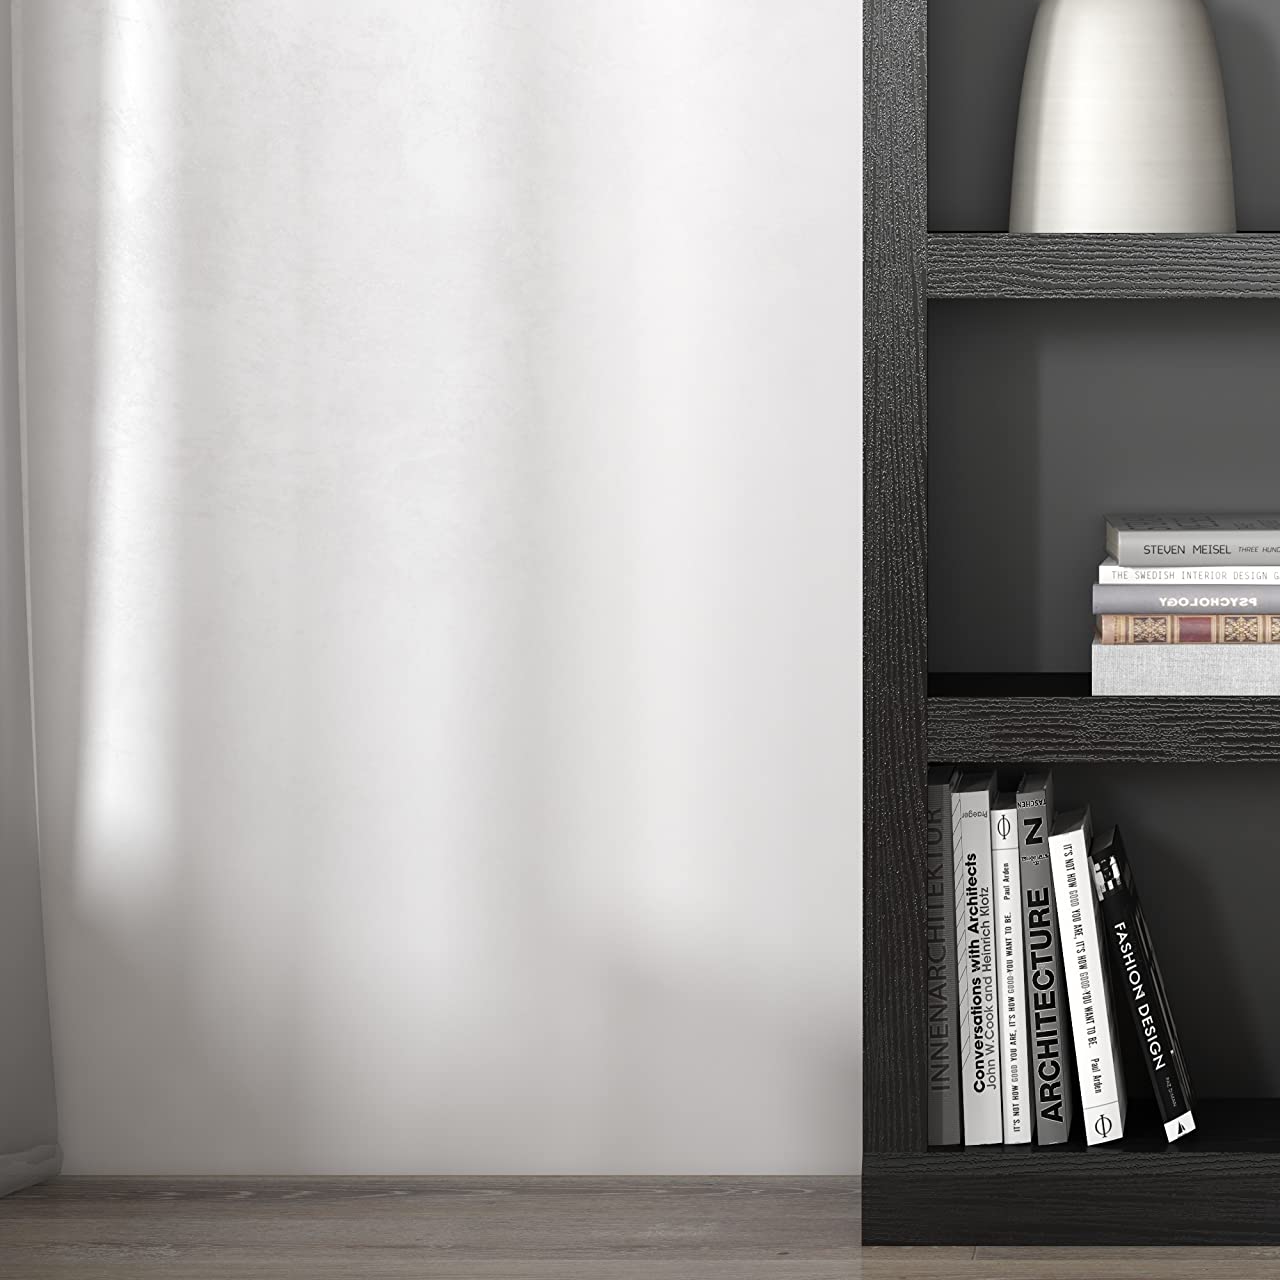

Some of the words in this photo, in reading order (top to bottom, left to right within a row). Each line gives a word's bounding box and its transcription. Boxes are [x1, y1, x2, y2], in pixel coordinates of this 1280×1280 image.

[1143, 545, 1186, 555] STEVEN
[1192, 545, 1231, 555] MEISEL
[1112, 571, 1129, 580] THE
[1135, 571, 1175, 580] SWEDISH
[1181, 571, 1227, 580] INTERIOR
[1233, 571, 1268, 580] DESIGN
[1017, 799, 1047, 808] TASCHEN
[962, 810, 988, 819] Praeger
[1063, 844, 1073, 857] IT'S
[1002, 862, 1010, 882] Arden
[1065, 858, 1075, 871] NOT
[1067, 873, 1077, 888] HOW
[964, 852, 980, 934] Architects
[1069, 890, 1079, 907] GOOD
[977, 886, 990, 917] Klotz
[1004, 912, 1012, 923] BE.
[1071, 908, 1081, 922] YOU
[1004, 926, 1012, 935] TO
[1073, 924, 1083, 940] ARE,
[928, 807, 950, 1091] INNENARCHITEKTUR
[978, 921, 991, 972] Heinrich
[1005, 937, 1013, 956] WANT
[1076, 941, 1085, 953] IT'S
[967, 940, 981, 973] with
[1078, 955, 1088, 970] HOW
[980, 975, 993, 1001] and
[1114, 921, 1146, 1002] FASHION
[1137, 1003, 1167, 1071] DESIGN
[1007, 996, 1015, 1012] HOW
[1026, 887, 1064, 1123] ARCHITECTURE
[1008, 1014, 1016, 1027] IT'S
[1084, 1006, 1095, 1025] WANT
[968, 977, 985, 1093] Conversations
[981, 1006, 995, 1054] W.Cook
[1009, 1029, 1018, 1046] ARE,
[1086, 1026, 1096, 1035] TO
[1088, 1036, 1098, 1048] BE.
[1010, 1064, 1018, 1082] GOOD
[1090, 1058, 1100, 1072] Paul
[983, 1058, 997, 1091] John
[1092, 1074, 1103, 1094] Arden
[1011, 1085, 1019, 1101] HOW
[1012, 1103, 1020, 1117] NOT
